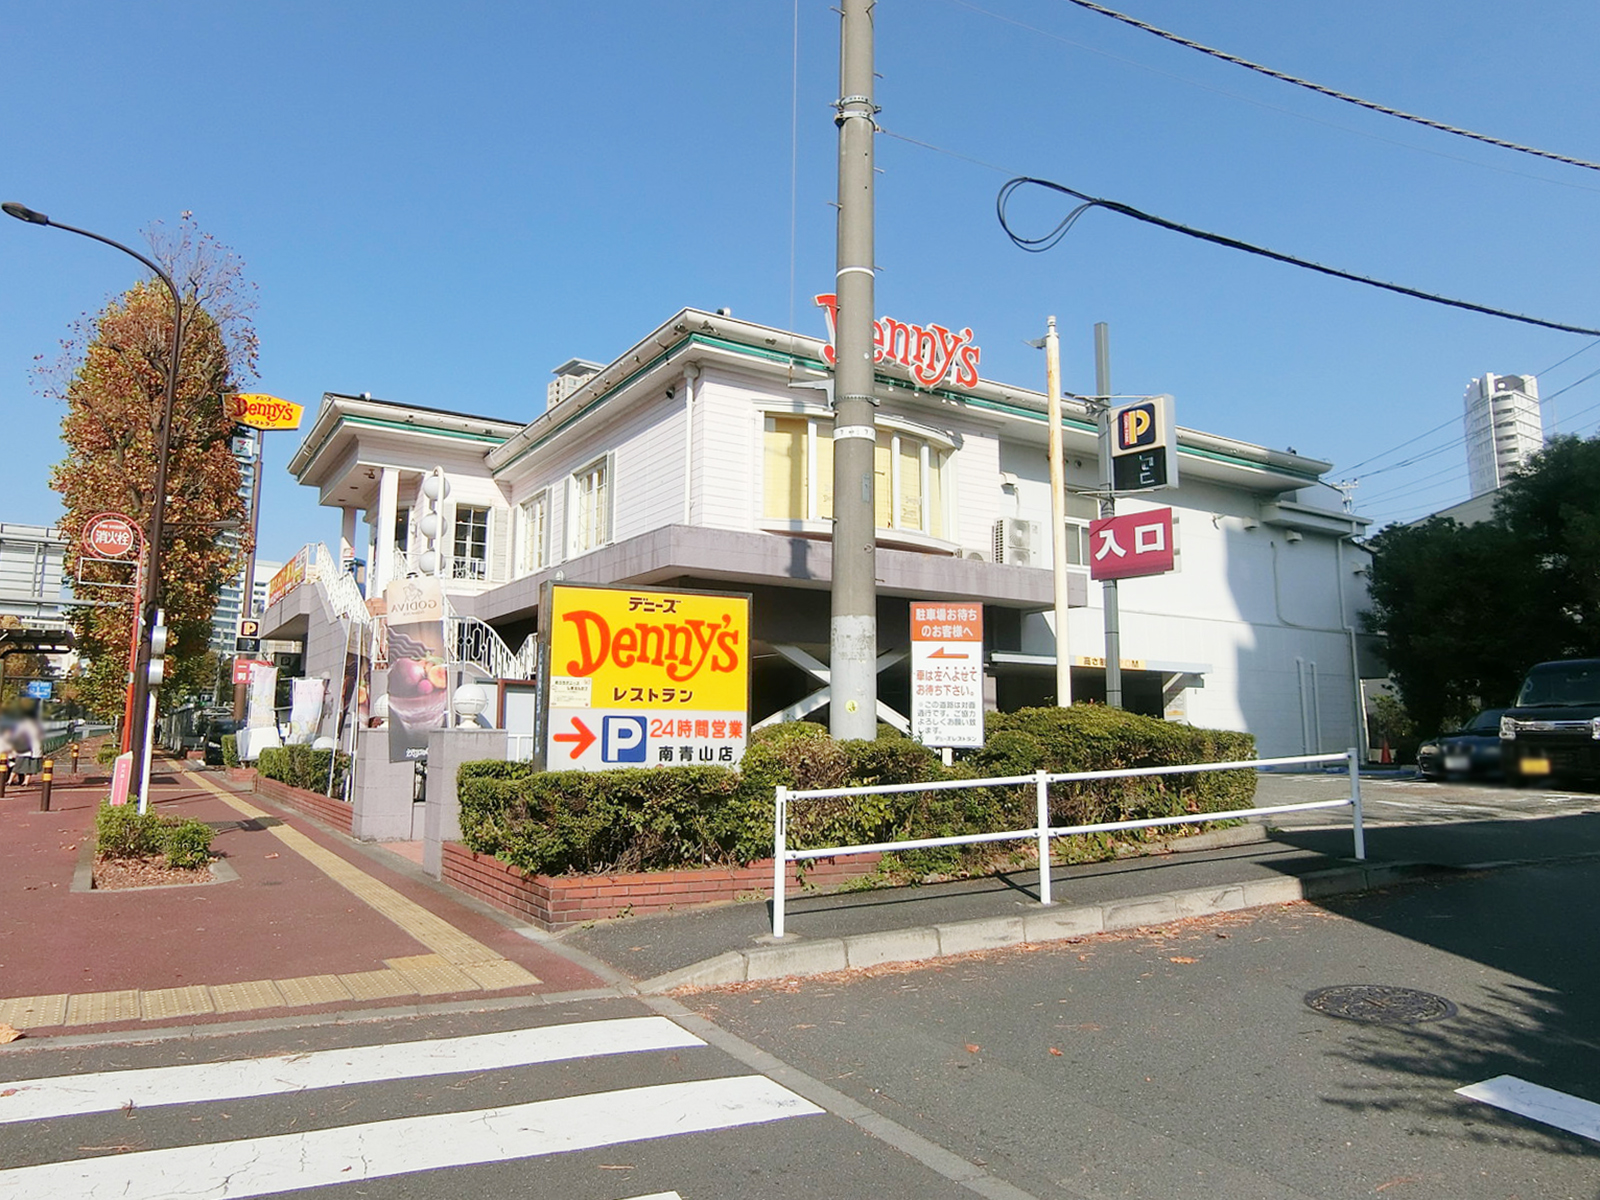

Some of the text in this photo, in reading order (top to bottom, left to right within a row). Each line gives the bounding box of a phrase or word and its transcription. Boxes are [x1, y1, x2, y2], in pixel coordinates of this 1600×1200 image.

[95, 529, 129, 546] 消火栓
[1095, 523, 1165, 560] 入口
[629, 597, 681, 613] デニーズ
[915, 608, 977, 621] 駐車場お待ち
[921, 625, 973, 638] のお客様へ
[562, 609, 739, 682] Denny's
[916, 669, 977, 682] 車は左へよせて
[613, 687, 693, 702] レストラン
[916, 684, 975, 696] お待ち下さい。
[650, 718, 743, 739] 24時間営業
[607, 718, 643, 761] P
[658, 745, 734, 762] 南青山店
